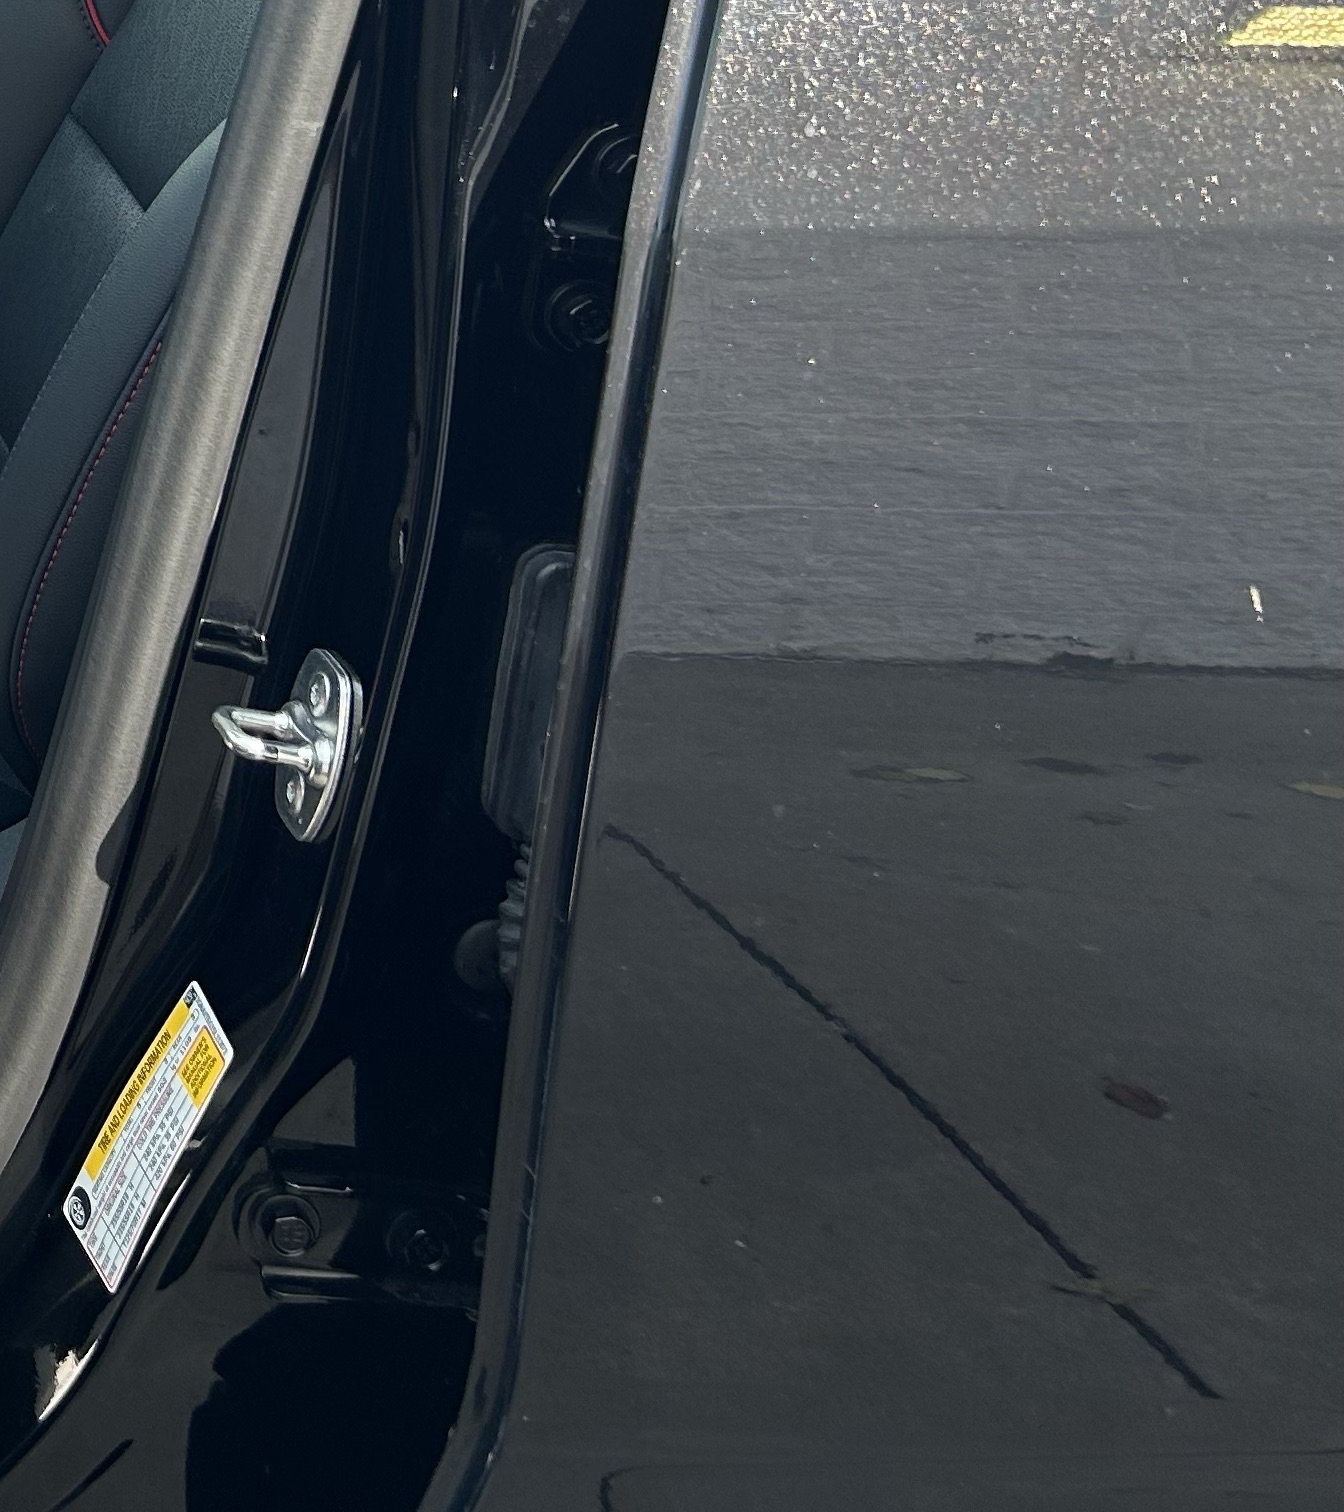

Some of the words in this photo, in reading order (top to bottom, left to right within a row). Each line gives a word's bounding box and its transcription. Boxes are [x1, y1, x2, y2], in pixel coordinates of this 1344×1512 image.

[98, 1130, 113, 1154] TIRE
[108, 1112, 122, 1137] AND
[120, 1078, 141, 1119] LOADING
[139, 1029, 172, 1088] INFORMATION
